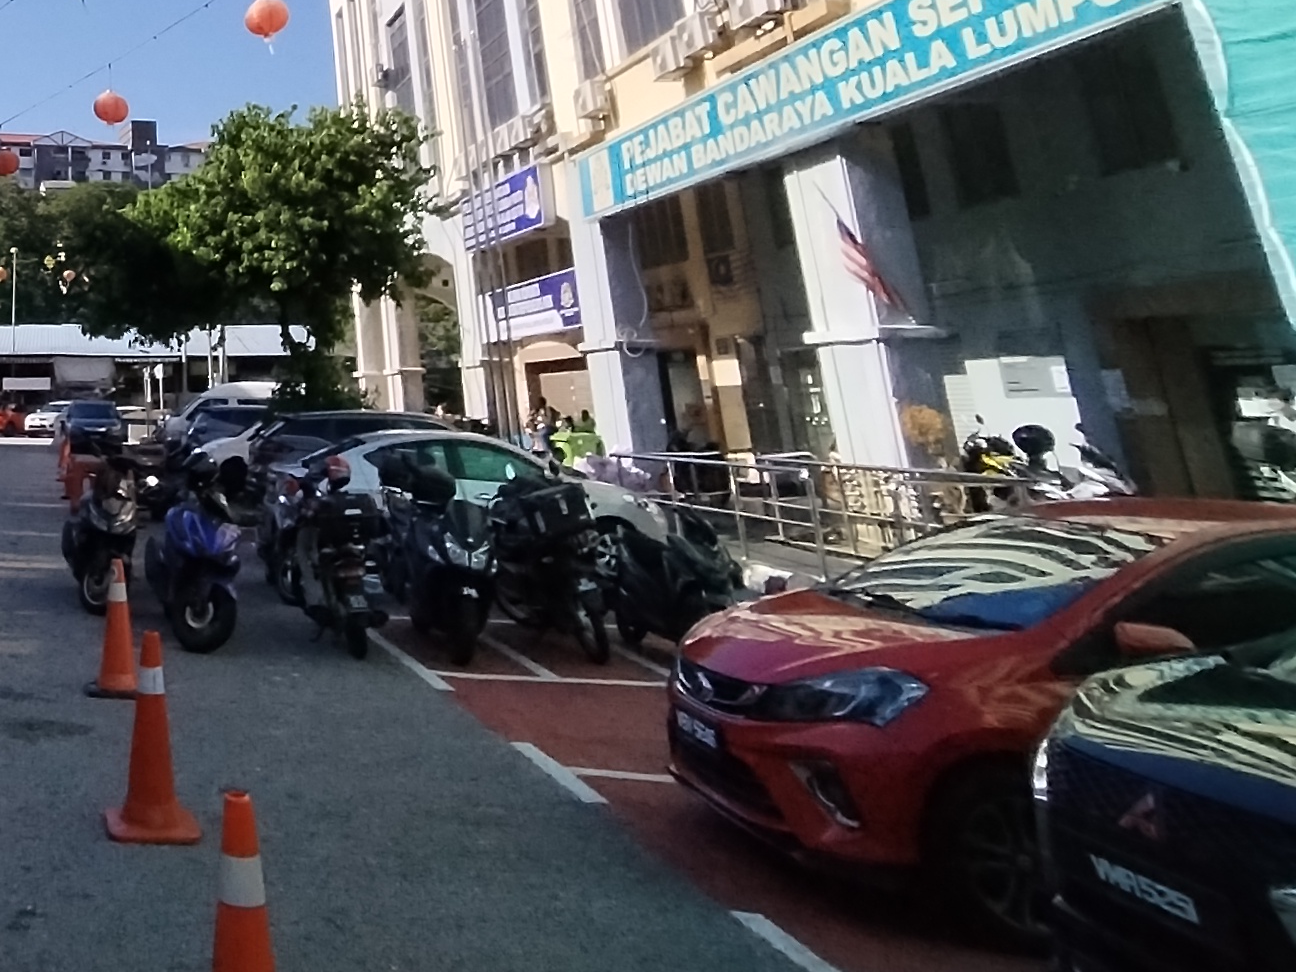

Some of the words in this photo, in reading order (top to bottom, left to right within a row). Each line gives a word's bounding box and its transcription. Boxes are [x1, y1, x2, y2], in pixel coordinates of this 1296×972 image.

[621, 100, 711, 171] PEJABAT
[716, 11, 902, 126] CAWANGAN
[624, 150, 689, 197] DEWAN
[690, 90, 834, 169] BANDARAYA
[838, 39, 957, 109] KUALA
